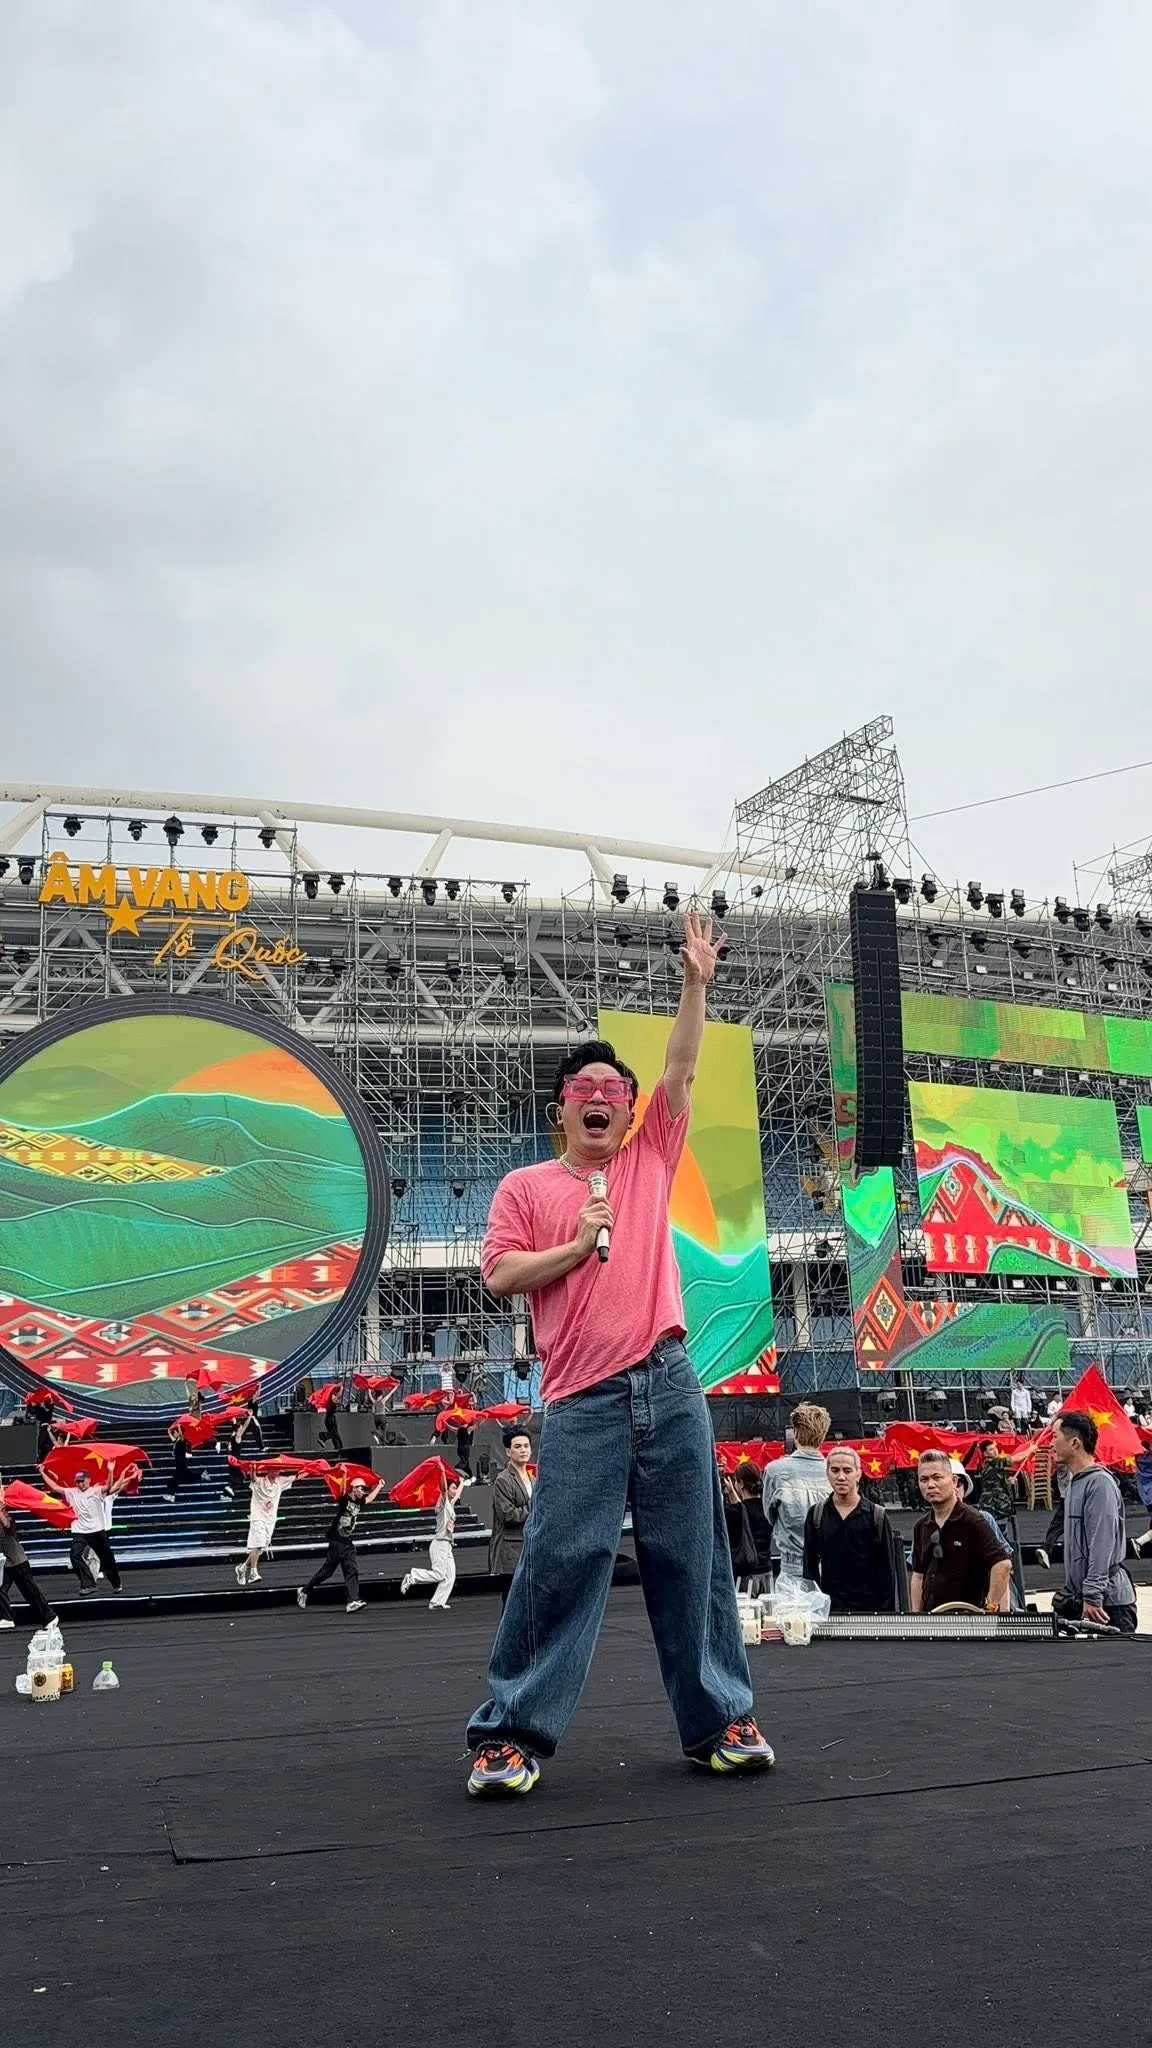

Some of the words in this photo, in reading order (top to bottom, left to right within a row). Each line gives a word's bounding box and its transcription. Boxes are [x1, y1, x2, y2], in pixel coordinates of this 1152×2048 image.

[39, 851, 117, 905] ÂM
[127, 866, 250, 912] VANG
[143, 916, 235, 965] Tổ
[212, 927, 307, 981] Quốc
